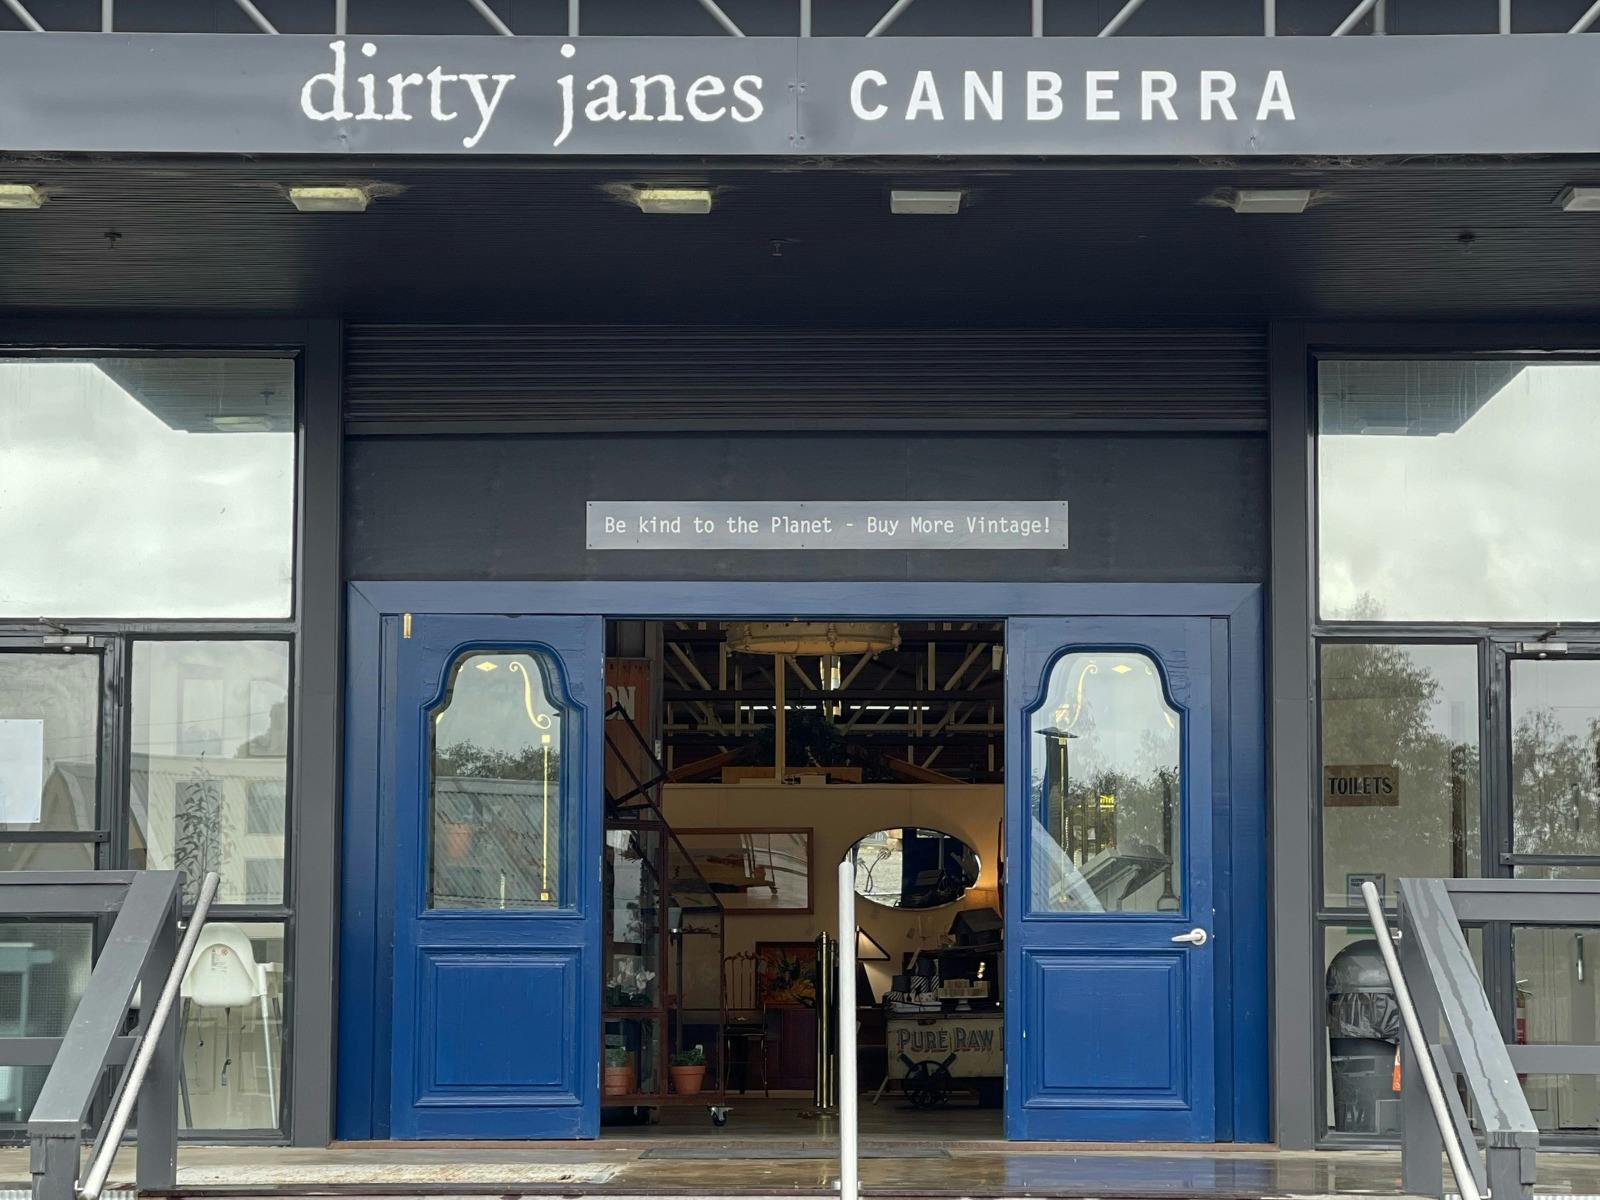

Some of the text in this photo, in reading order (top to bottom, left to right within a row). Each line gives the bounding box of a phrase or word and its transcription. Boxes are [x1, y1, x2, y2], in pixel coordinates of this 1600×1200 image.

[301, 41, 1295, 148] dirty janes CANBERRA
[605, 516, 627, 534] Be
[639, 515, 681, 534] kind
[693, 516, 715, 534] to
[726, 516, 759, 534] the
[771, 516, 833, 534] Planet
[867, 516, 900, 537] Buy
[911, 516, 955, 534] More
[966, 516, 1050, 537] Vintage!
[1328, 777, 1393, 795] TOILETS
[897, 1028, 948, 1053] PURE
[953, 1027, 994, 1052] RAW
